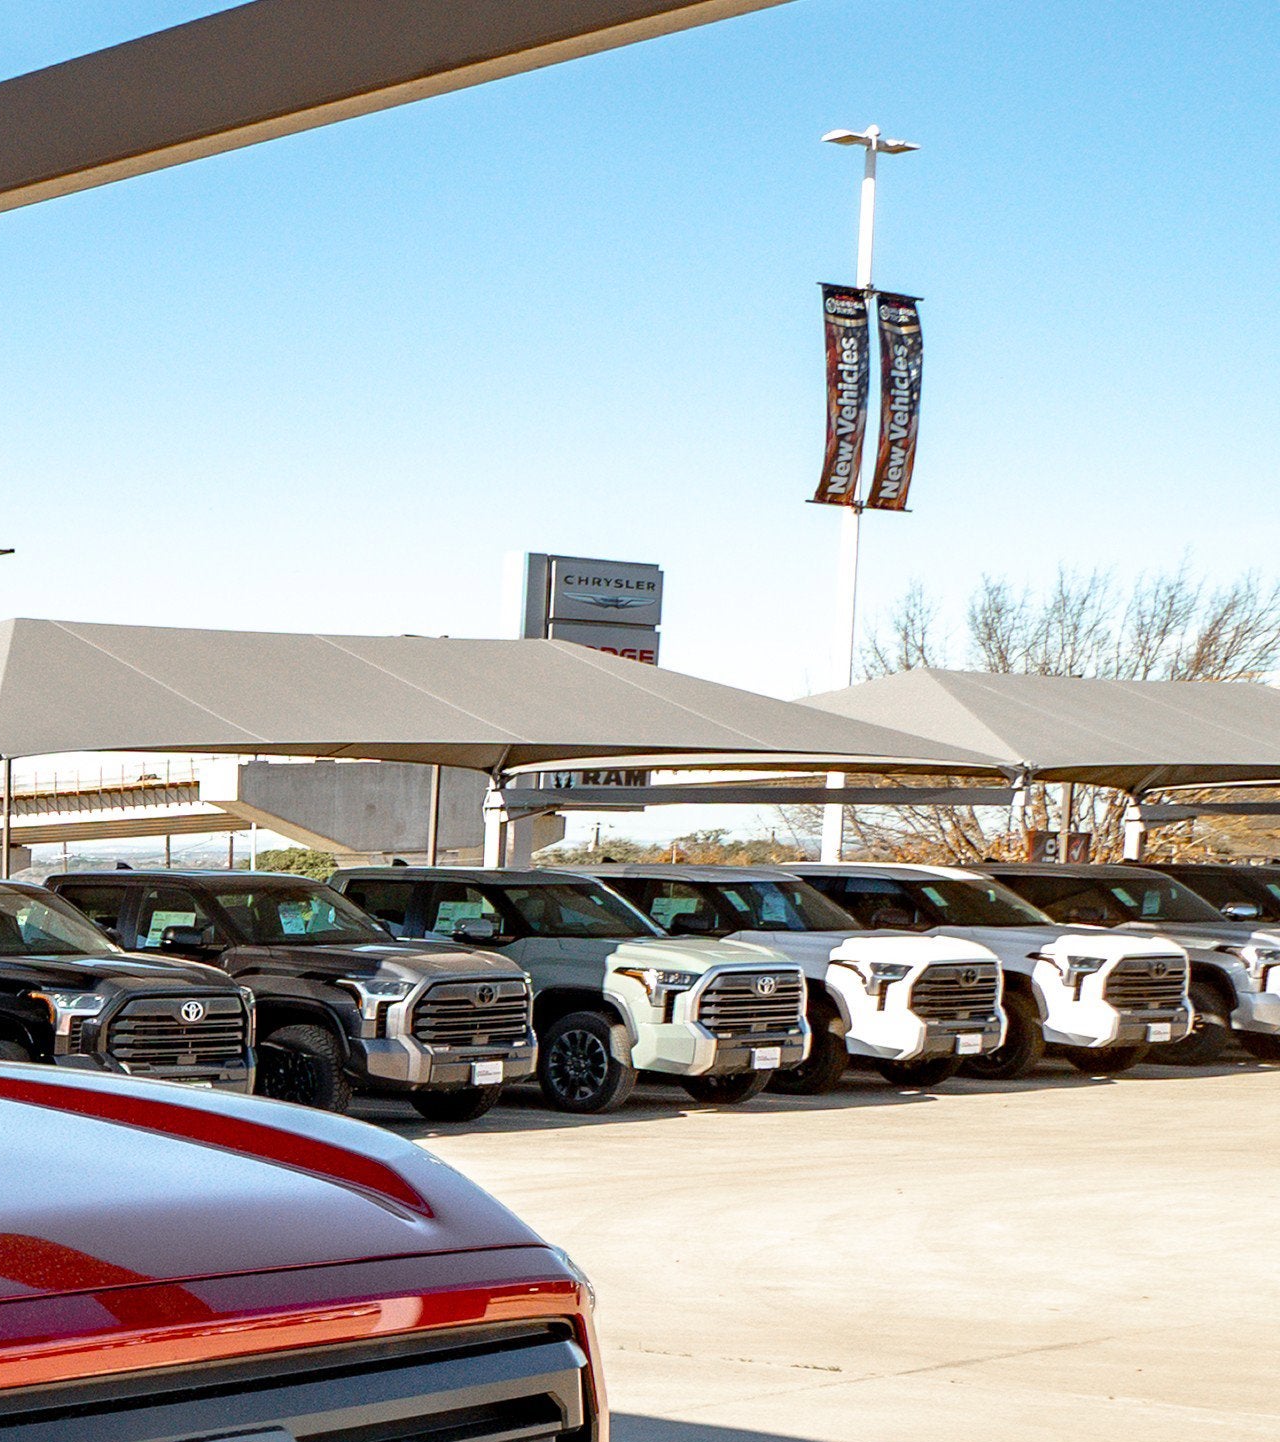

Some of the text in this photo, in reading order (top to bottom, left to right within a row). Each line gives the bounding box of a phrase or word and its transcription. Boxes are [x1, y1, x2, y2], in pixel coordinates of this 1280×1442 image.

[837, 336, 858, 436] Vehicles
[888, 344, 910, 441] Vehicles
[827, 441, 854, 494] New
[878, 445, 906, 499] New
[563, 574, 656, 592] CHRYSLER
[581, 769, 646, 787] RAM
